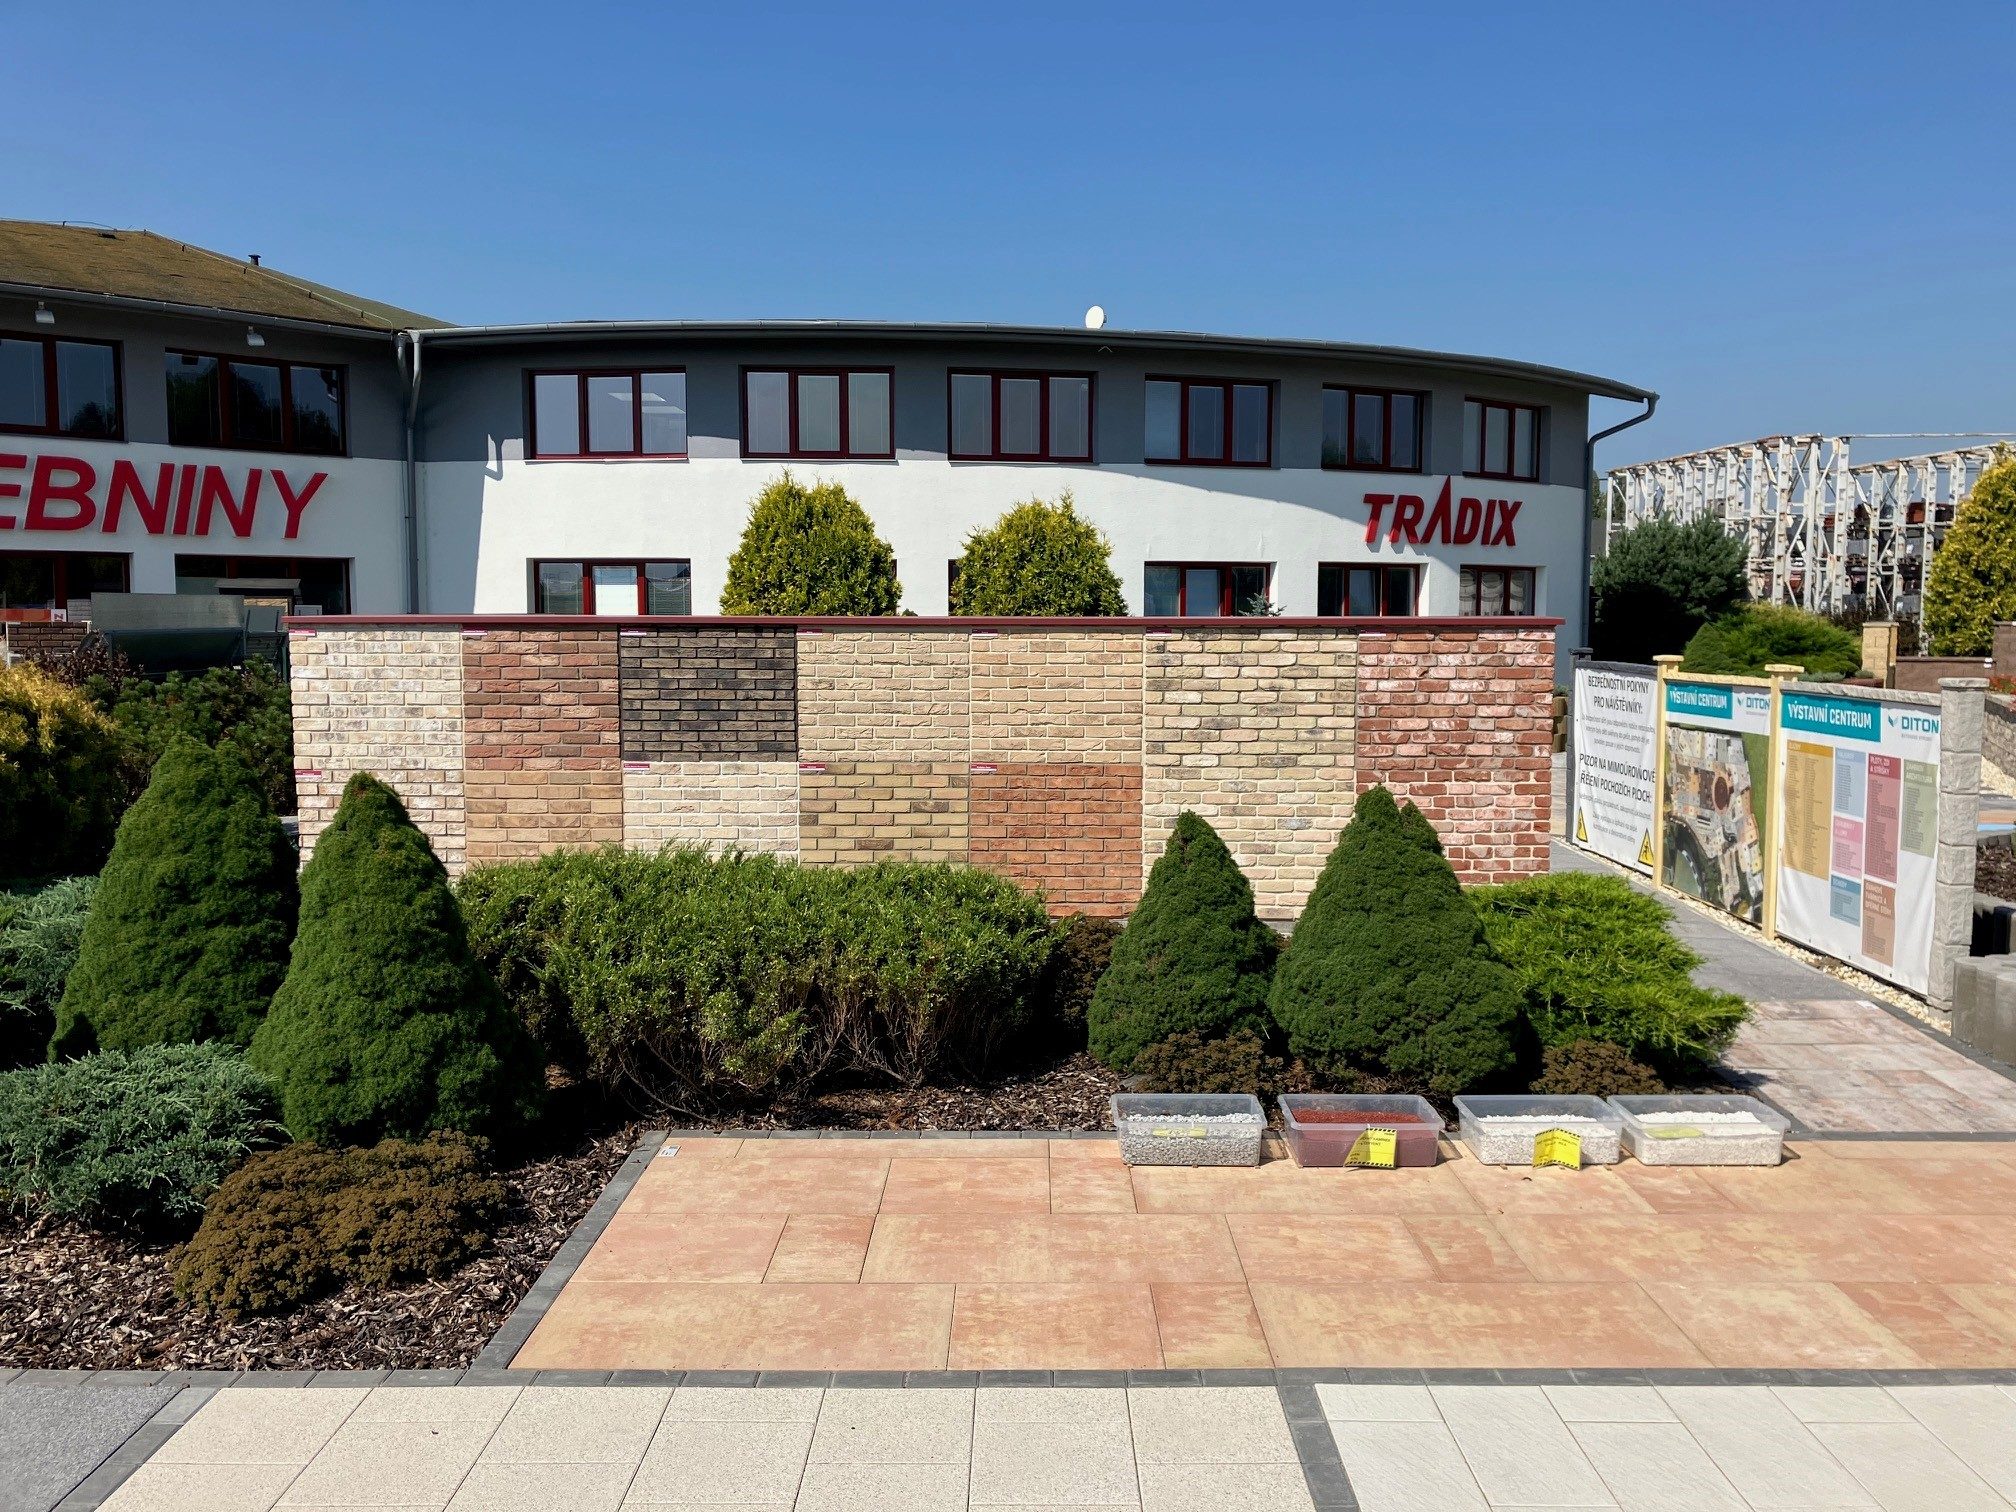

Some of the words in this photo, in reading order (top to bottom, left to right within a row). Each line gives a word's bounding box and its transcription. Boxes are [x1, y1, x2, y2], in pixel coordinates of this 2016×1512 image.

[1363, 475, 1523, 547] TRADIX
[1588, 674, 1626, 691] BEZPEČNOSTNÍ
[1626, 680, 1650, 694] POKYNY
[1593, 695, 1605, 708] PRO
[1669, 687, 1697, 706] VÝSTAVNÍ
[1698, 693, 1728, 709] CENTRUM
[1746, 697, 1770, 710] DITON
[1788, 701, 1828, 723] VÝSTAVNÍ
[1829, 708, 1872, 729] CENTRUM
[1901, 716, 1939, 733] DITON
[1598, 758, 1607, 770] NA
